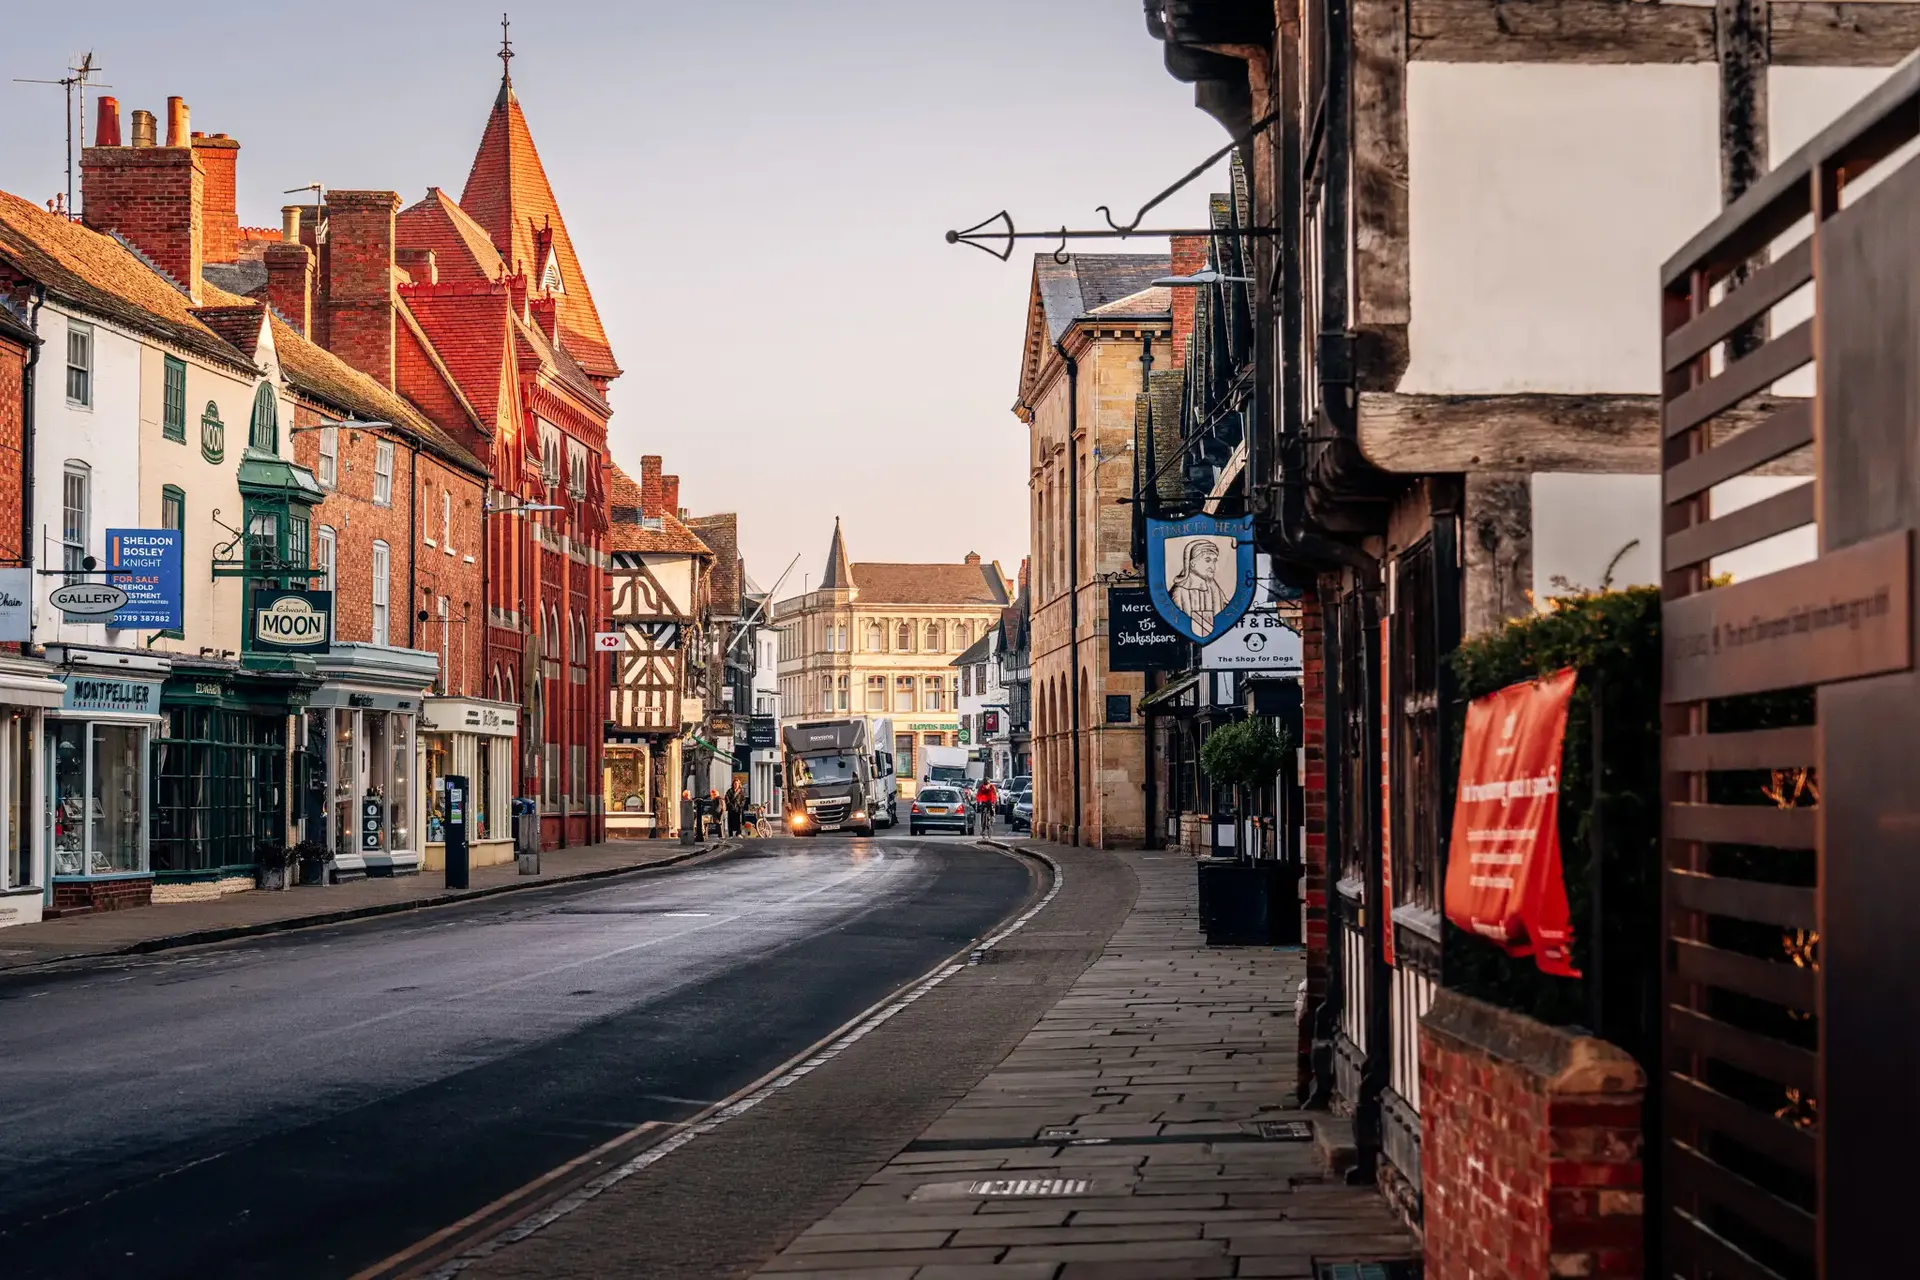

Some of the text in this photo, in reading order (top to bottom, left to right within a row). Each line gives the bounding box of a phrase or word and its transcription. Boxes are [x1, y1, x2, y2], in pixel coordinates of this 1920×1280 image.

[202, 422, 223, 452] MOON
[1152, 521, 1208, 537] CHAUCER
[123, 536, 173, 545] SHELDON
[123, 548, 164, 556] BOSLEY
[58, 593, 120, 604] GALLERY
[128, 592, 162, 600] ESTMENT
[276, 605, 308, 614] Edward
[1121, 603, 1153, 613] Merc
[263, 614, 322, 636] MOON
[1137, 617, 1157, 631] The
[1249, 617, 1260, 628] &
[1117, 631, 1177, 646] Shakespeare
[74, 680, 150, 704] MONTPELLIER
